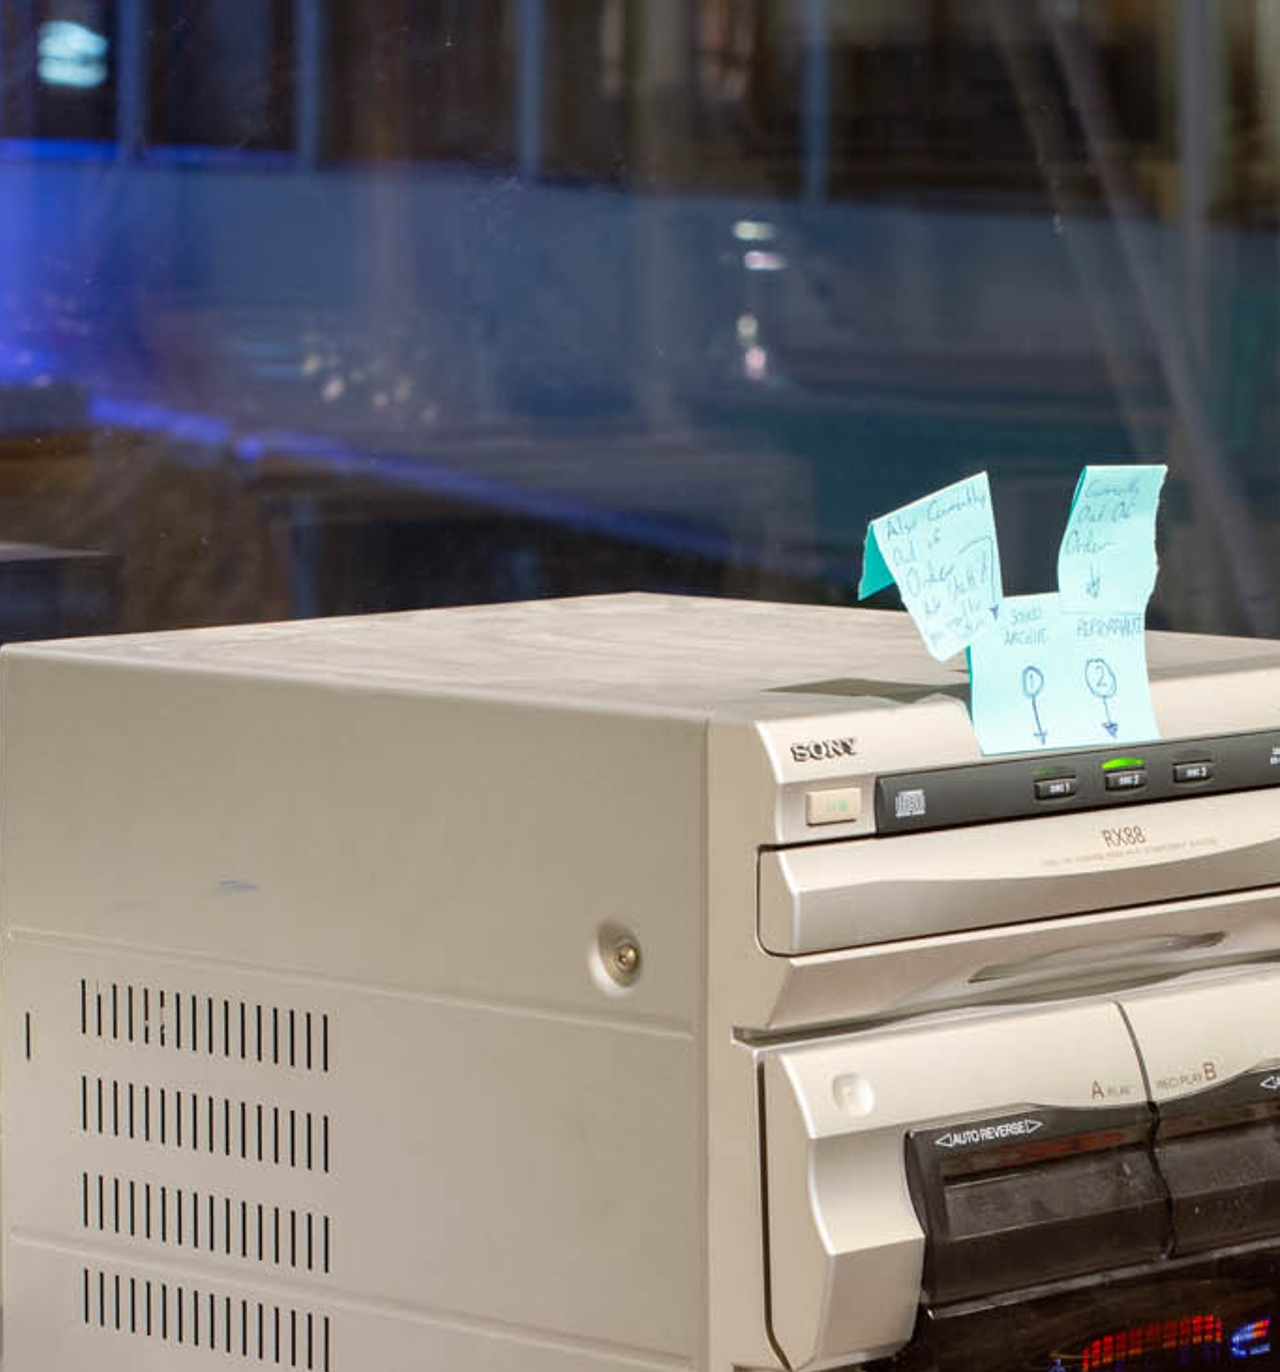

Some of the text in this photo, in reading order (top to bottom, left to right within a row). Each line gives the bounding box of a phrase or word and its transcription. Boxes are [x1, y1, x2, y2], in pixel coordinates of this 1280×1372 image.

[790, 737, 857, 763] SONY
[1101, 824, 1147, 848] RX88
[1202, 1061, 1218, 1082] B
[1091, 1079, 1105, 1100] A
[953, 1121, 1026, 1145] AUTO REVERSE
